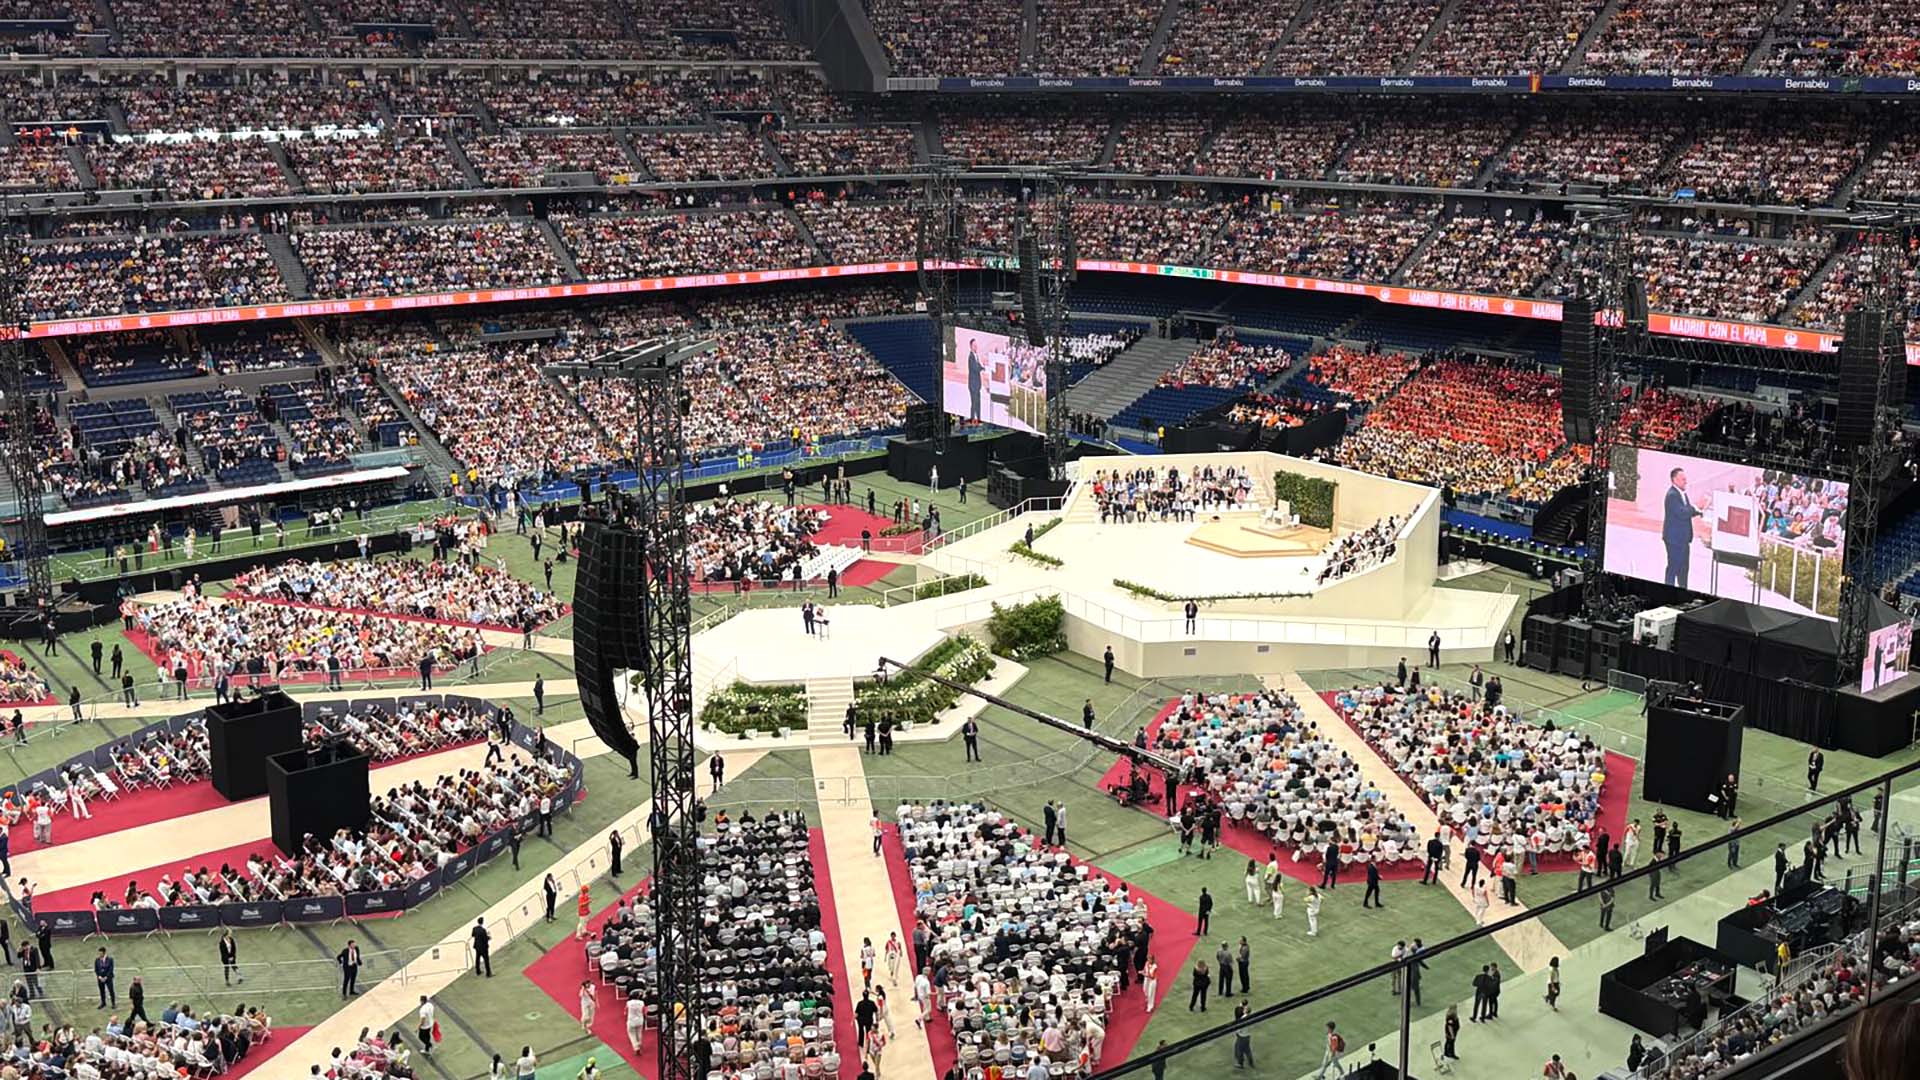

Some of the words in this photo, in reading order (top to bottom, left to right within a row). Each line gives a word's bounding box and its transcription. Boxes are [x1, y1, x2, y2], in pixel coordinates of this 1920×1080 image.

[1039, 79, 1073, 87] Bernabéu
[1214, 79, 1244, 87] Bernabéu
[1295, 78, 1327, 87] Bernabéu
[1380, 78, 1414, 87] Bernabéu
[1472, 78, 1508, 87] Bernabéu
[1568, 77, 1606, 87] Bernabéu
[1672, 77, 1713, 88] Bernabéu
[1785, 78, 1830, 89] Bernabéu
[1470, 296, 1488, 311] PAPA
[1670, 318, 1706, 338] MADRID
[1708, 322, 1728, 340] CON
[1731, 325, 1740, 342] EL
[1744, 326, 1767, 345] PAPA
